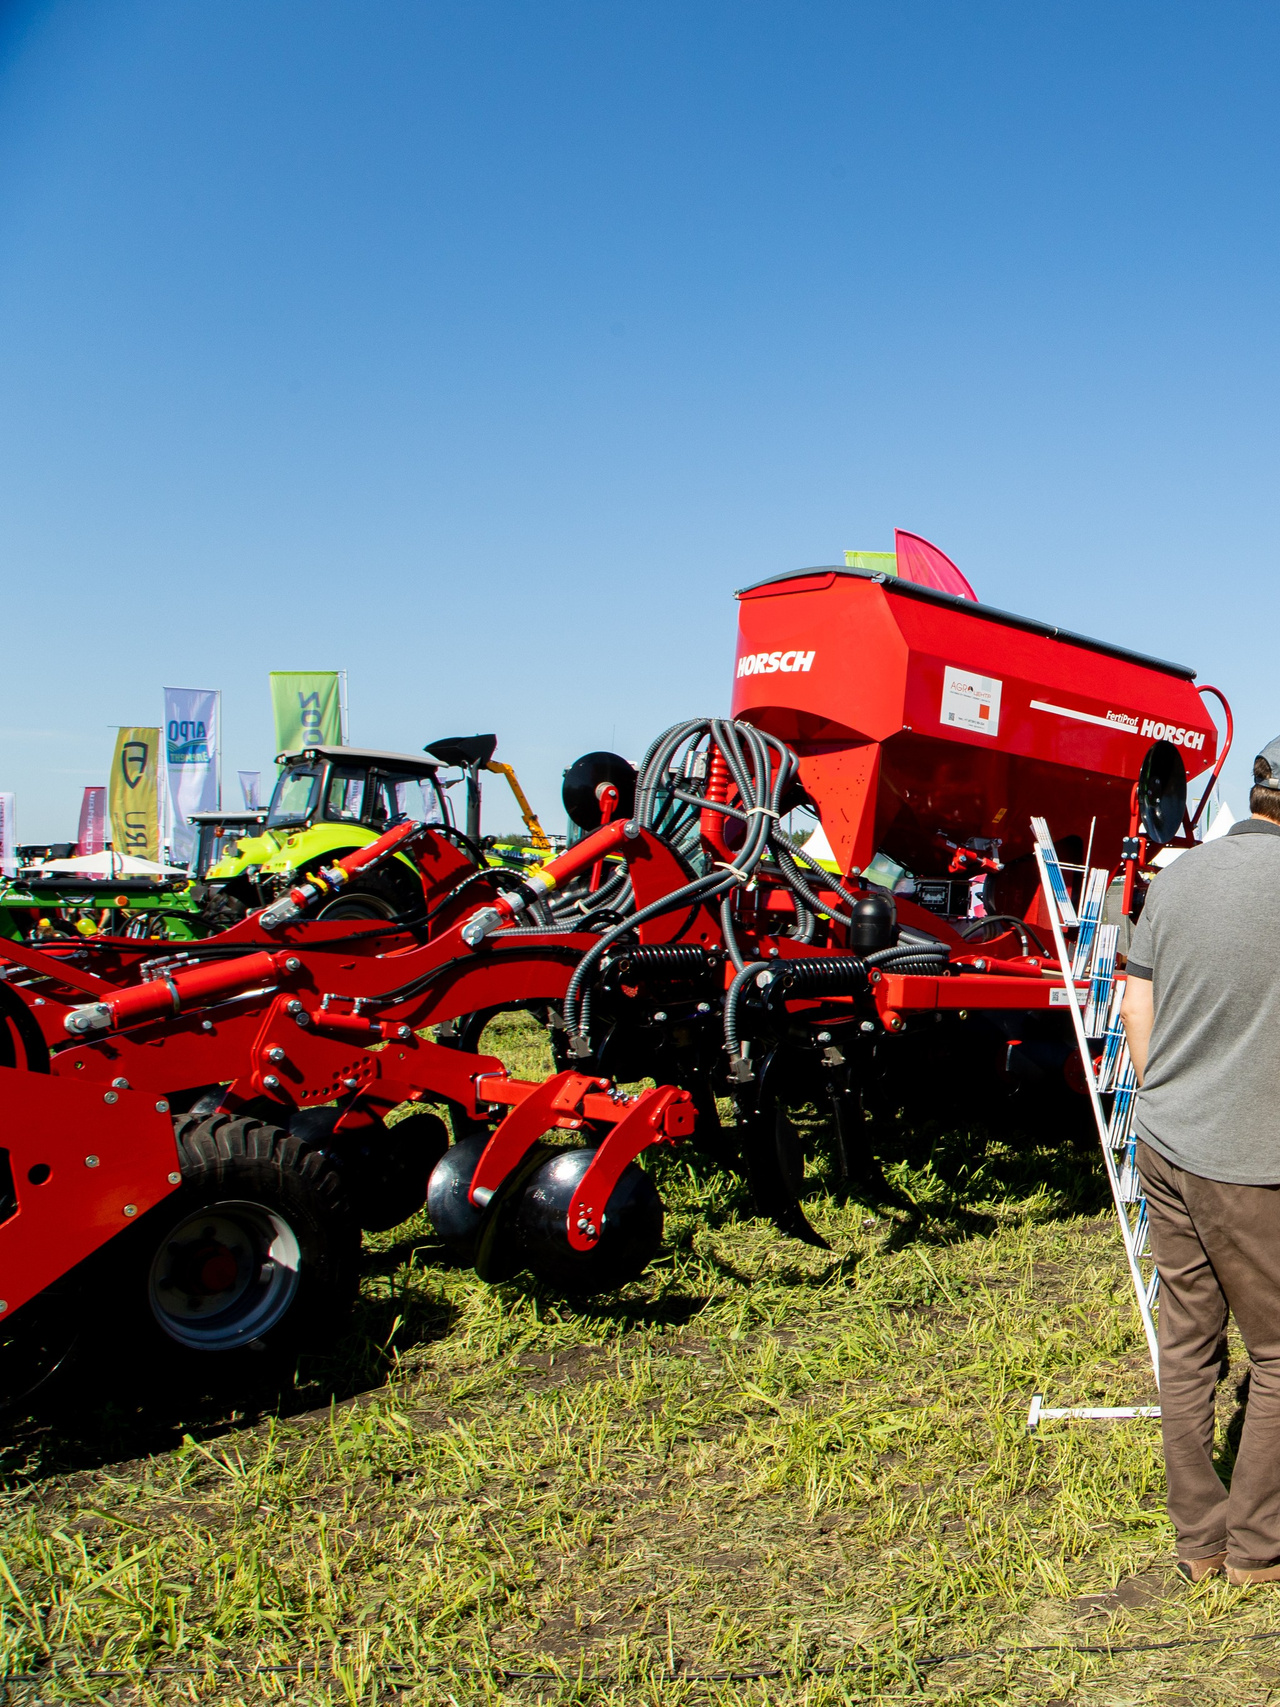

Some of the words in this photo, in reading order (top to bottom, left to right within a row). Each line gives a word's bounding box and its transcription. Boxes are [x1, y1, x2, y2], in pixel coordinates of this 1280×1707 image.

[736, 650, 816, 679] HORSCH
[1105, 710, 1139, 726] FertiProf
[1140, 718, 1206, 751] HORSCH
